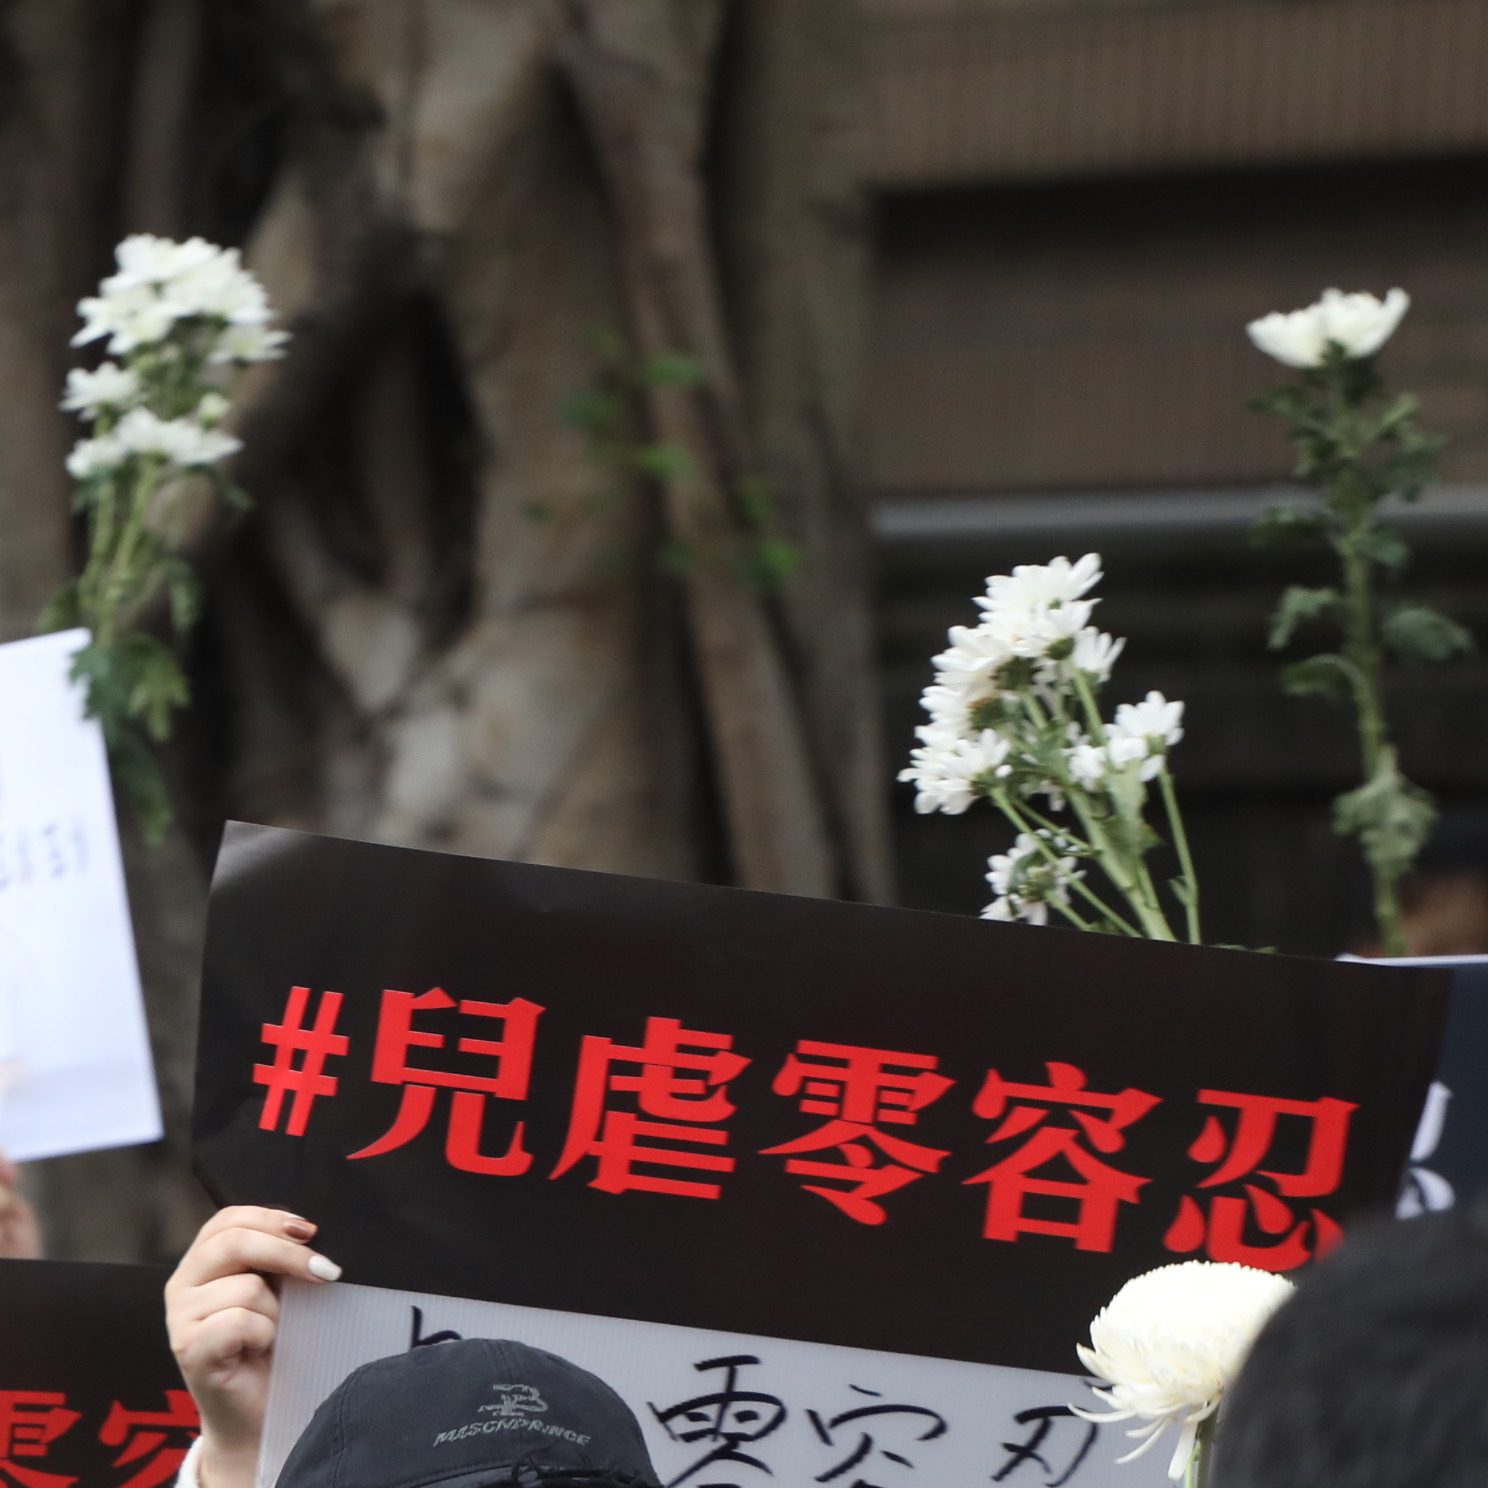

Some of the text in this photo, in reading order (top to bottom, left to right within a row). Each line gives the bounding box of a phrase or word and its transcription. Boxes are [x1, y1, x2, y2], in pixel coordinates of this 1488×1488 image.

[252, 986, 1359, 1273] #兒虐零容忍
